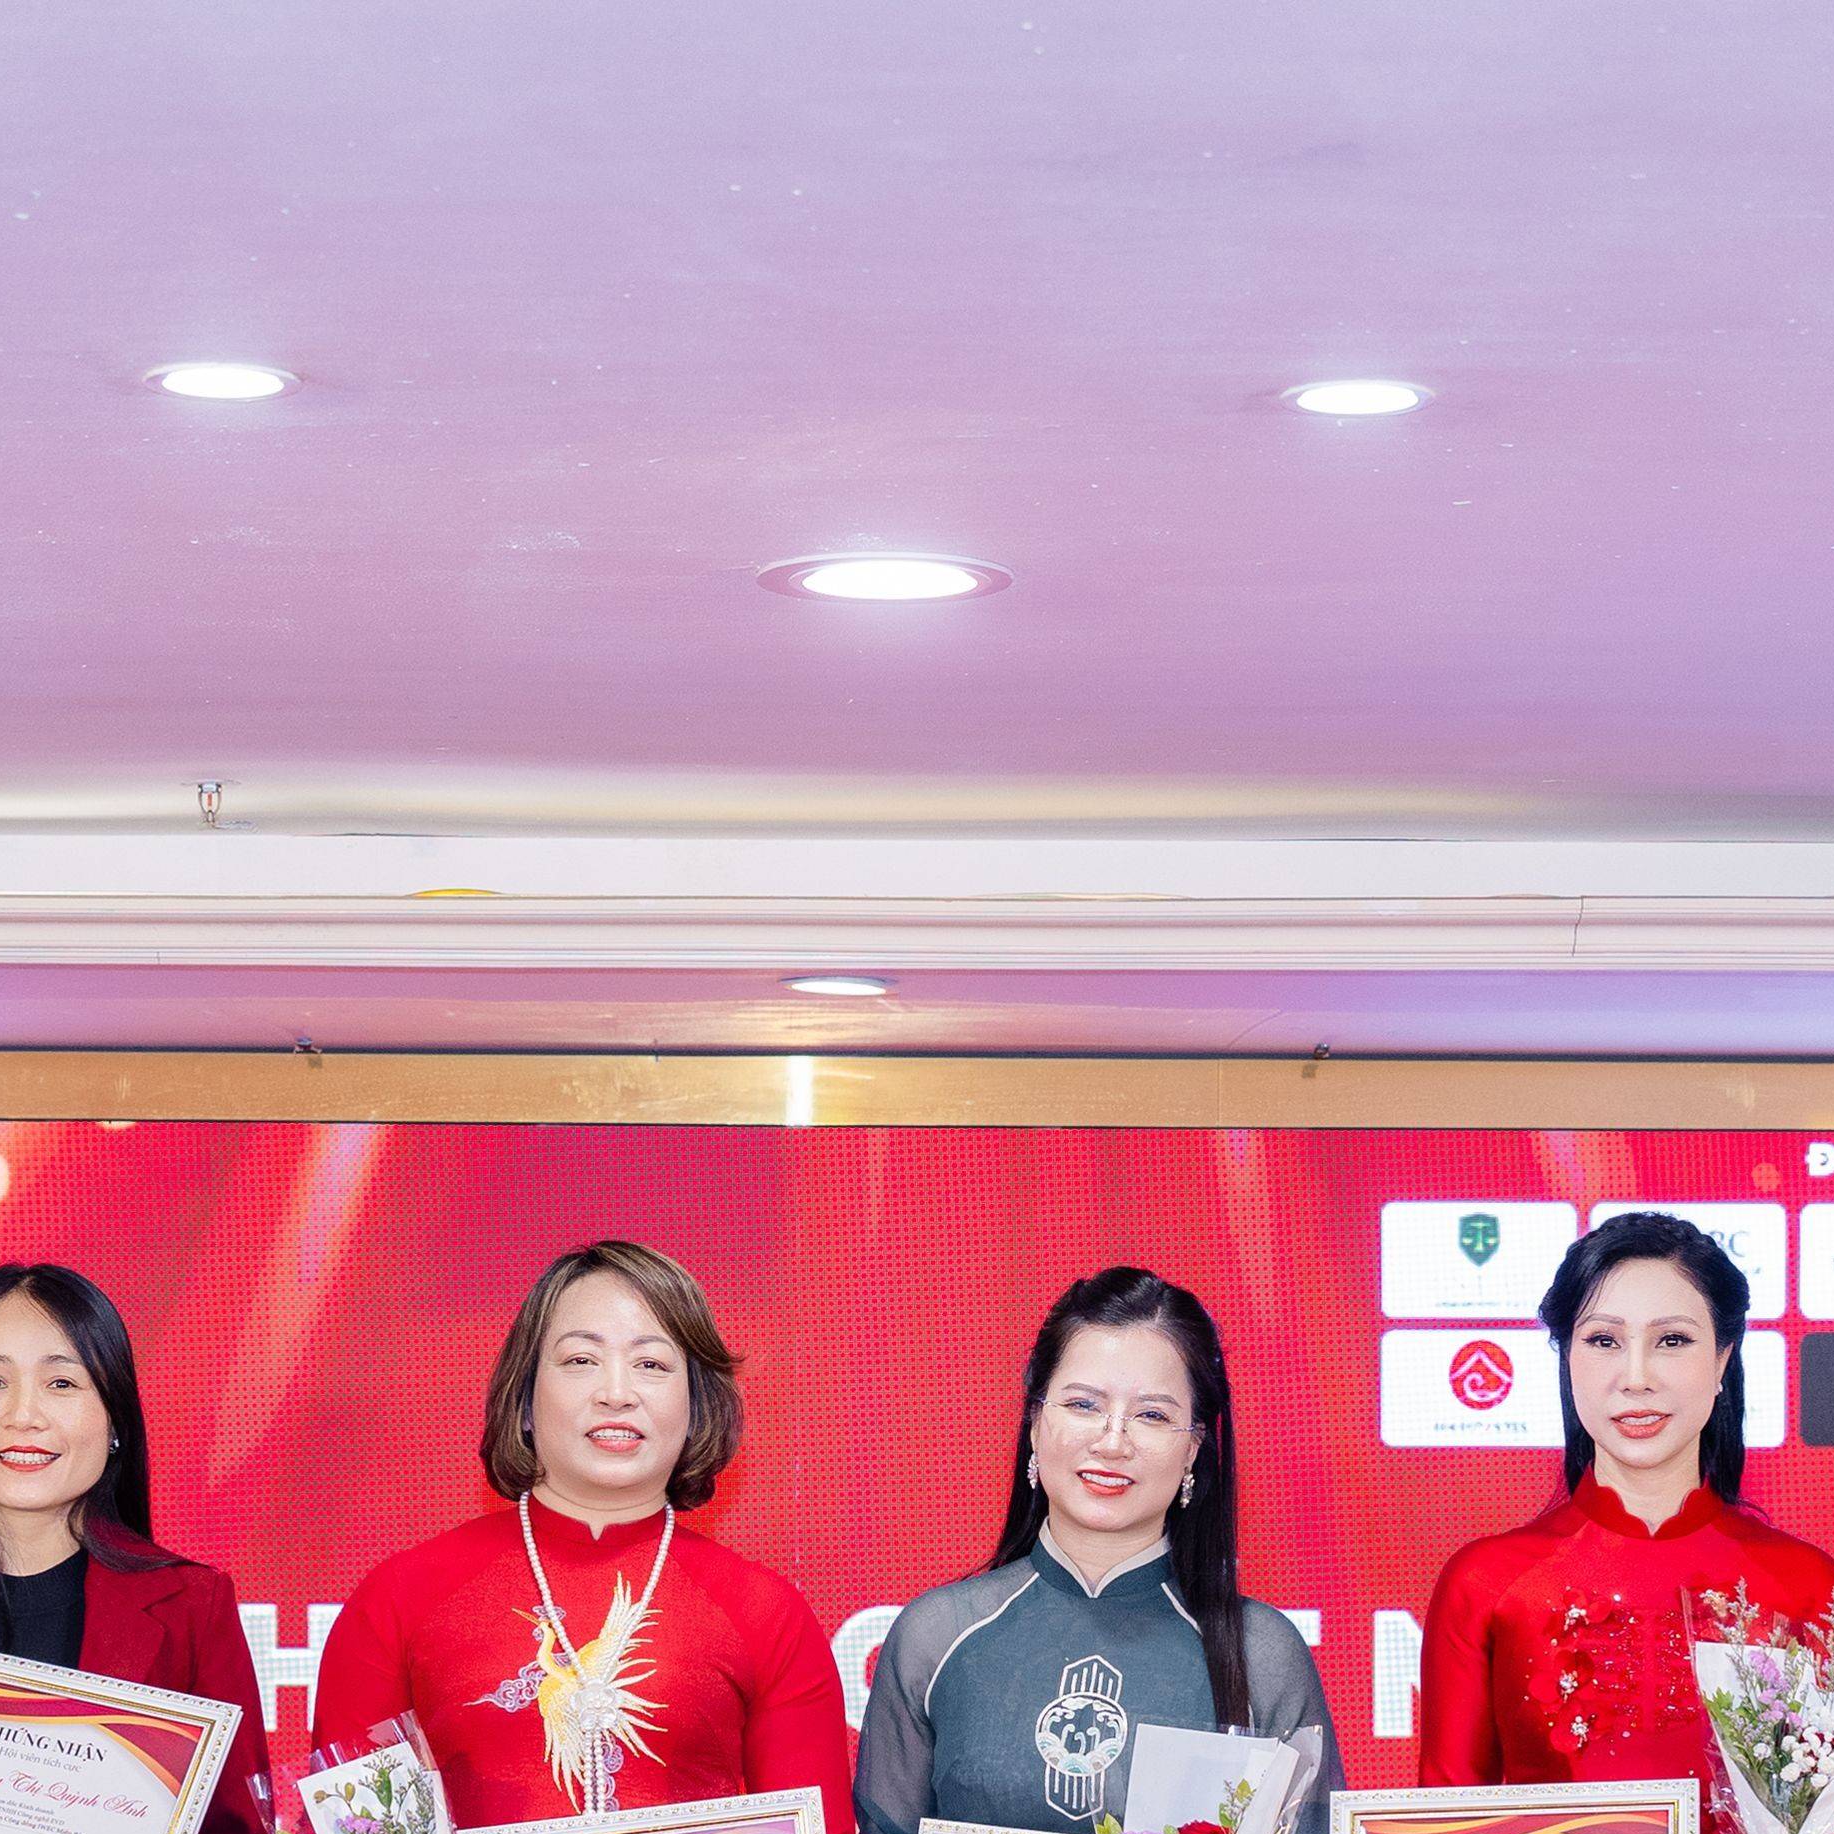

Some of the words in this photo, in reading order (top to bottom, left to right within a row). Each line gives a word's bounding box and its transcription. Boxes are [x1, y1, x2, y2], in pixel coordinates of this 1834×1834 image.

[20, 1751, 41, 1763] viên
[42, 1755, 61, 1768] tích
[54, 1740, 107, 1763] NHẬN
[9, 1768, 44, 1797] Thị
